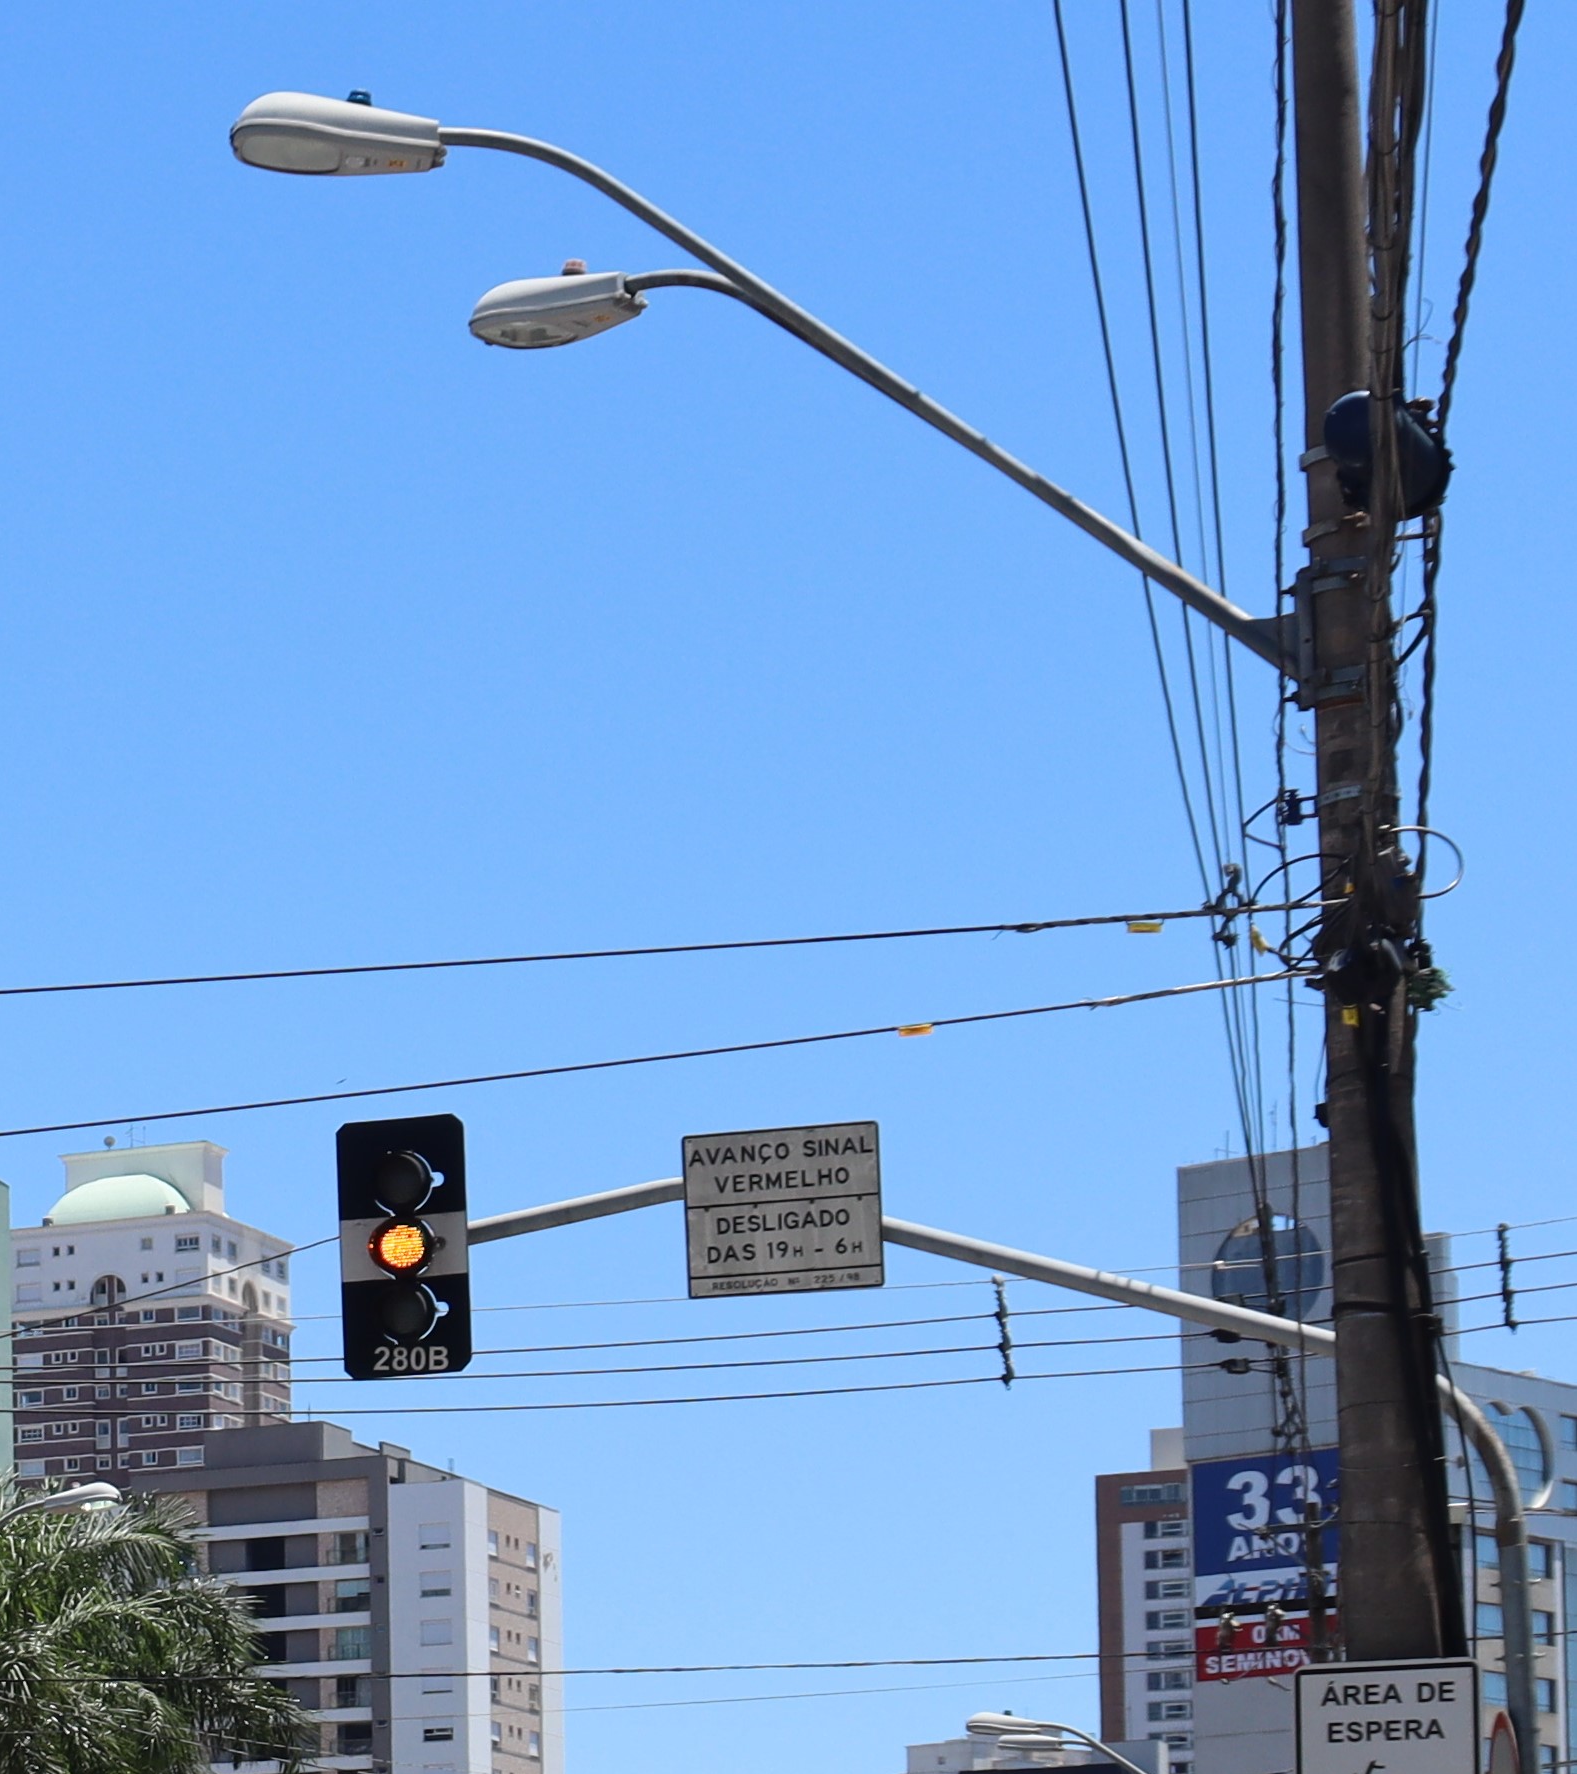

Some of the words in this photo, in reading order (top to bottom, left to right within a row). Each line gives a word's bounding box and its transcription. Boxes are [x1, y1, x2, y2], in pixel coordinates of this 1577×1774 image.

[689, 1142, 790, 1167] AVANÇO
[803, 1136, 874, 1158] SINAL
[715, 1167, 850, 1194] VERMELHO
[717, 1208, 850, 1235] DESLIGADO
[707, 1243, 756, 1264] DAS
[712, 1277, 779, 1291] RESOLUÇÃO
[373, 1345, 450, 1371] 280B
[1226, 1464, 1323, 1532] 33
[1227, 1532, 1310, 1563] ANO
[1321, 1681, 1403, 1707] ÁREA
[1417, 1681, 1457, 1703] DE
[1327, 1718, 1445, 1743] ESPERA
